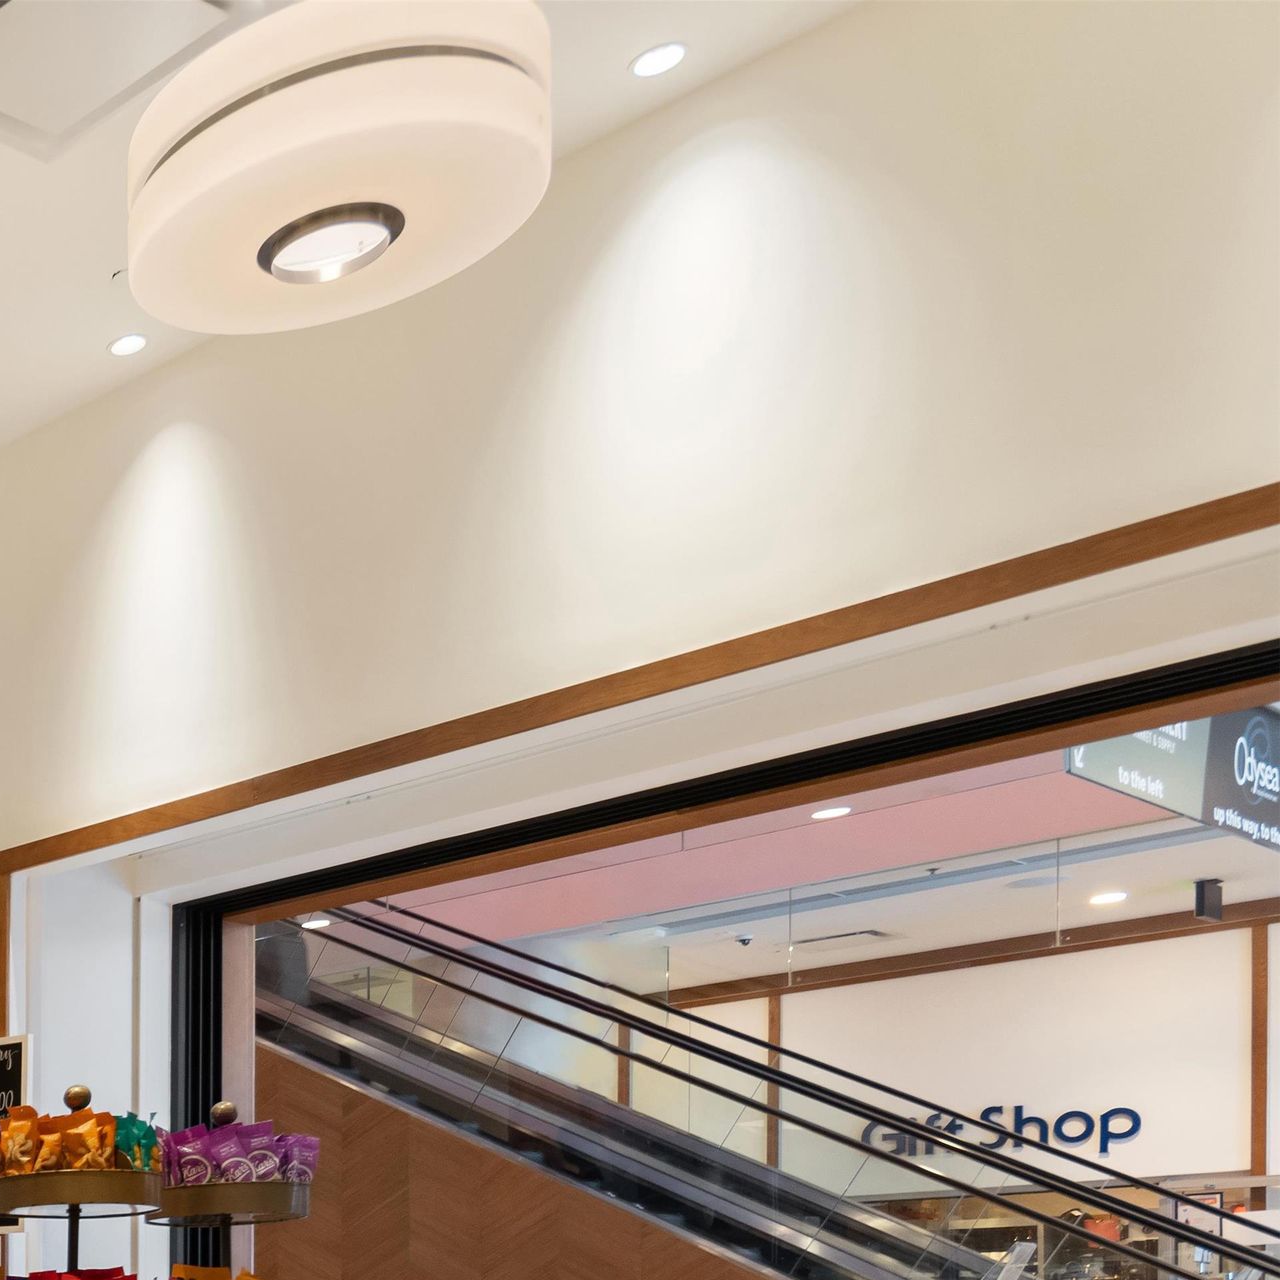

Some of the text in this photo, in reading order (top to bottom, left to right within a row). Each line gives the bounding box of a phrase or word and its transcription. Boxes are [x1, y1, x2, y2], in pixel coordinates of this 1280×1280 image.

[1118, 766, 1164, 799] to the left
[1214, 806, 1225, 826] up
[1226, 808, 1242, 828] this
[1243, 816, 1260, 840] way,
[1261, 824, 1270, 840] to
[980, 1105, 1142, 1154] Shop
